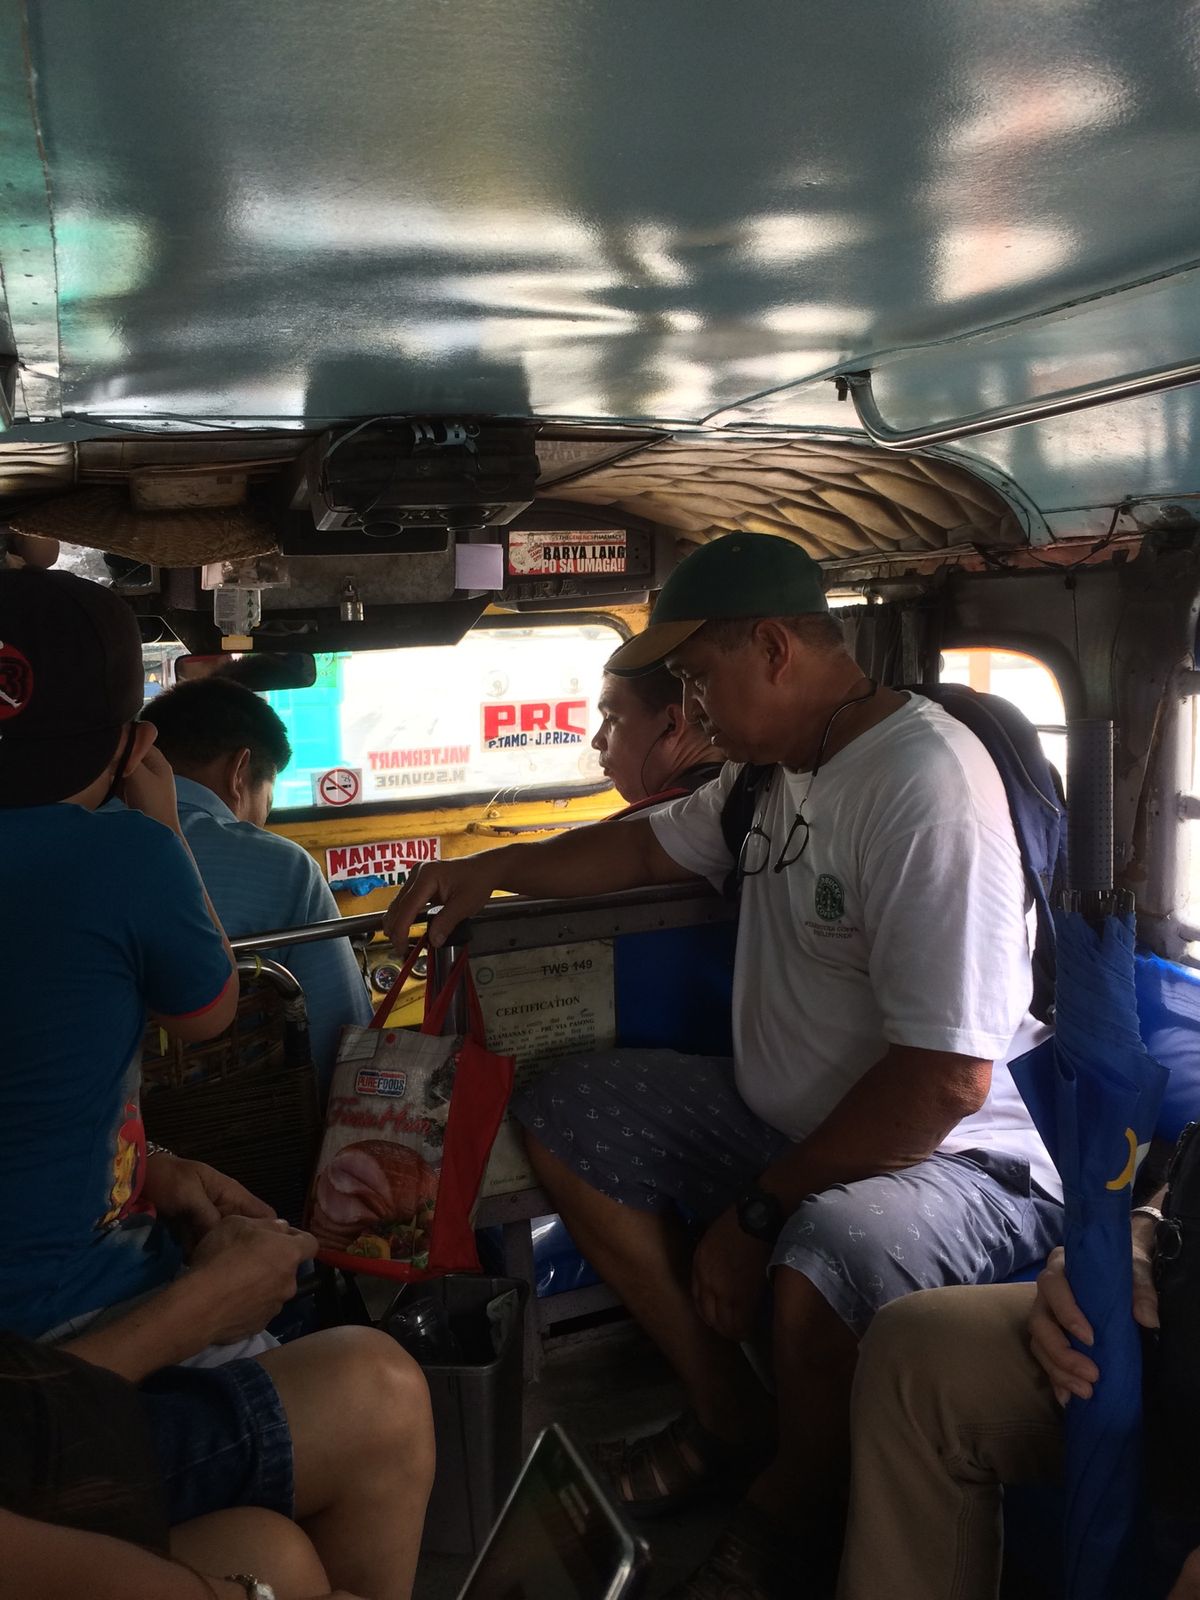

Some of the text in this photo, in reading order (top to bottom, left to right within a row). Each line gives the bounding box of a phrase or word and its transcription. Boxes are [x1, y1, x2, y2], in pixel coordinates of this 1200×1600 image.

[543, 546, 587, 560] BARYA
[592, 545, 626, 559] LANG
[541, 558, 626, 573] PO SA UMAGA!!
[484, 701, 587, 742] PRC
[488, 734, 528, 749] P.TAMO
[329, 839, 438, 876] MANTRADE
[347, 860, 419, 877] MRT
[541, 962, 569, 976] TWS
[496, 996, 581, 1018] CERTIFICATION
[357, 1077, 404, 1091] PUREFOODS
